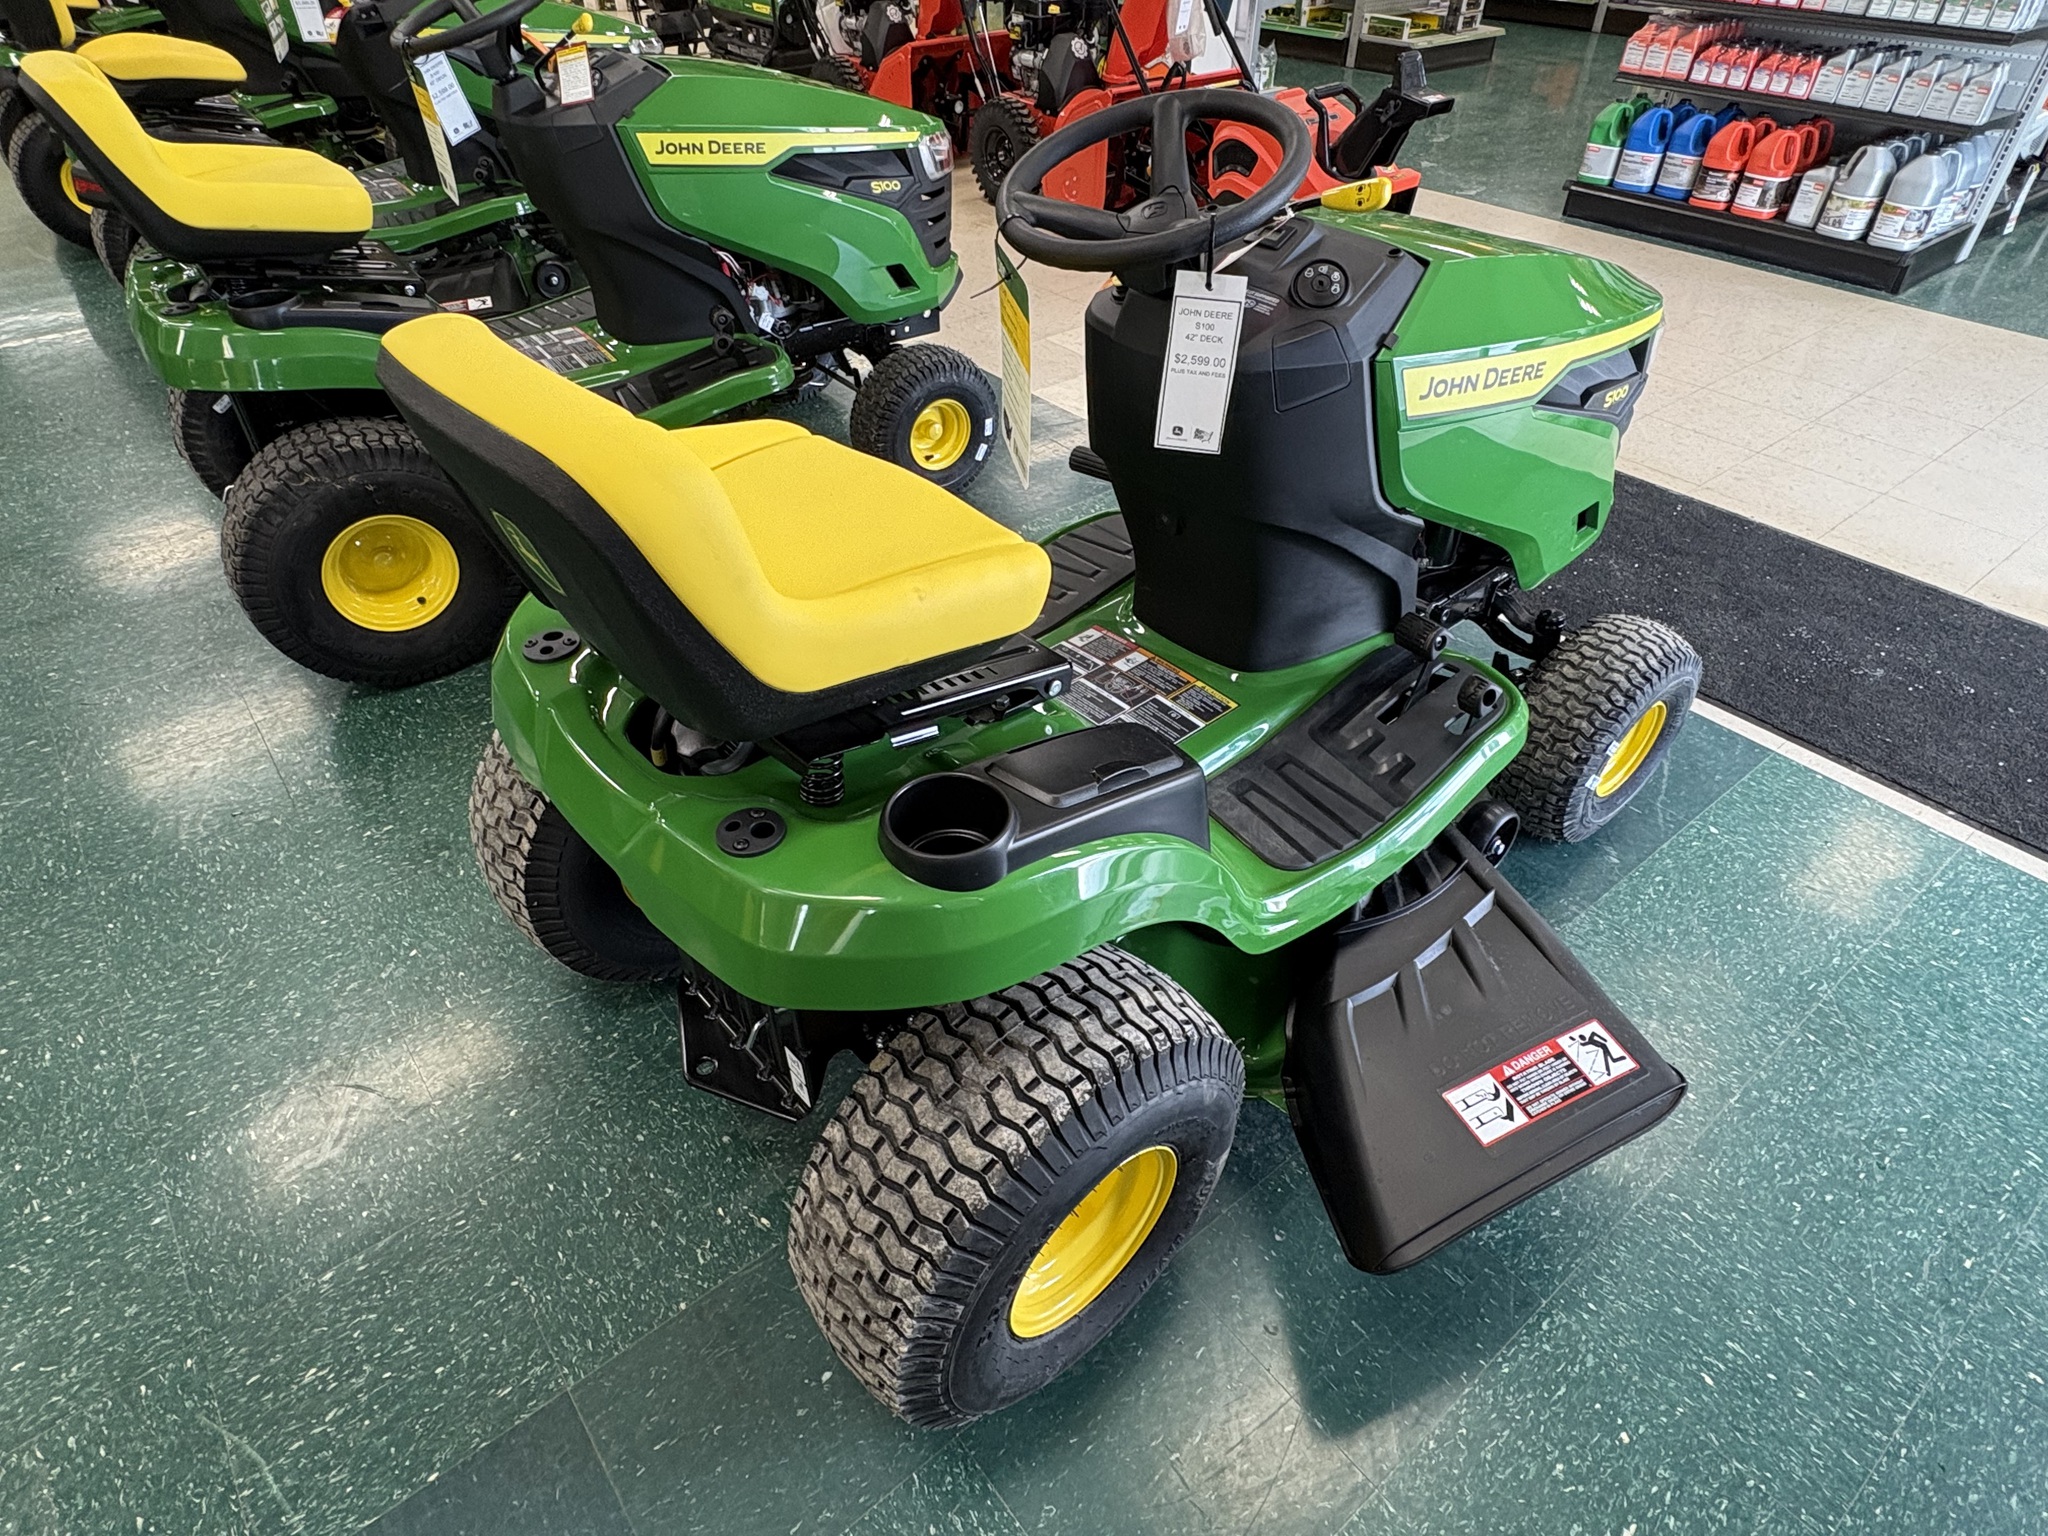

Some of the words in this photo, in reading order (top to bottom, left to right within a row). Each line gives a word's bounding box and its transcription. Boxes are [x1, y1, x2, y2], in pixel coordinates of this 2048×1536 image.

[655, 140, 704, 155] JOHN
[708, 140, 767, 154] DEERE
[870, 180, 902, 194] S100
[1178, 307, 1202, 317] JOHN
[1204, 310, 1234, 320] DEERE
[1195, 321, 1215, 331] S100
[1185, 333, 1199, 341] 42"
[1200, 335, 1224, 344] DECK
[1174, 353, 1226, 368] $2,599.00
[1170, 367, 1186, 375] PLUS
[1186, 368, 1198, 376] TAX
[1211, 371, 1226, 379] FEES
[1419, 374, 1480, 401] JOHN
[1482, 361, 1547, 390] DEERE
[1603, 385, 1630, 409] S100
[1510, 1045, 1554, 1071] DANGER
